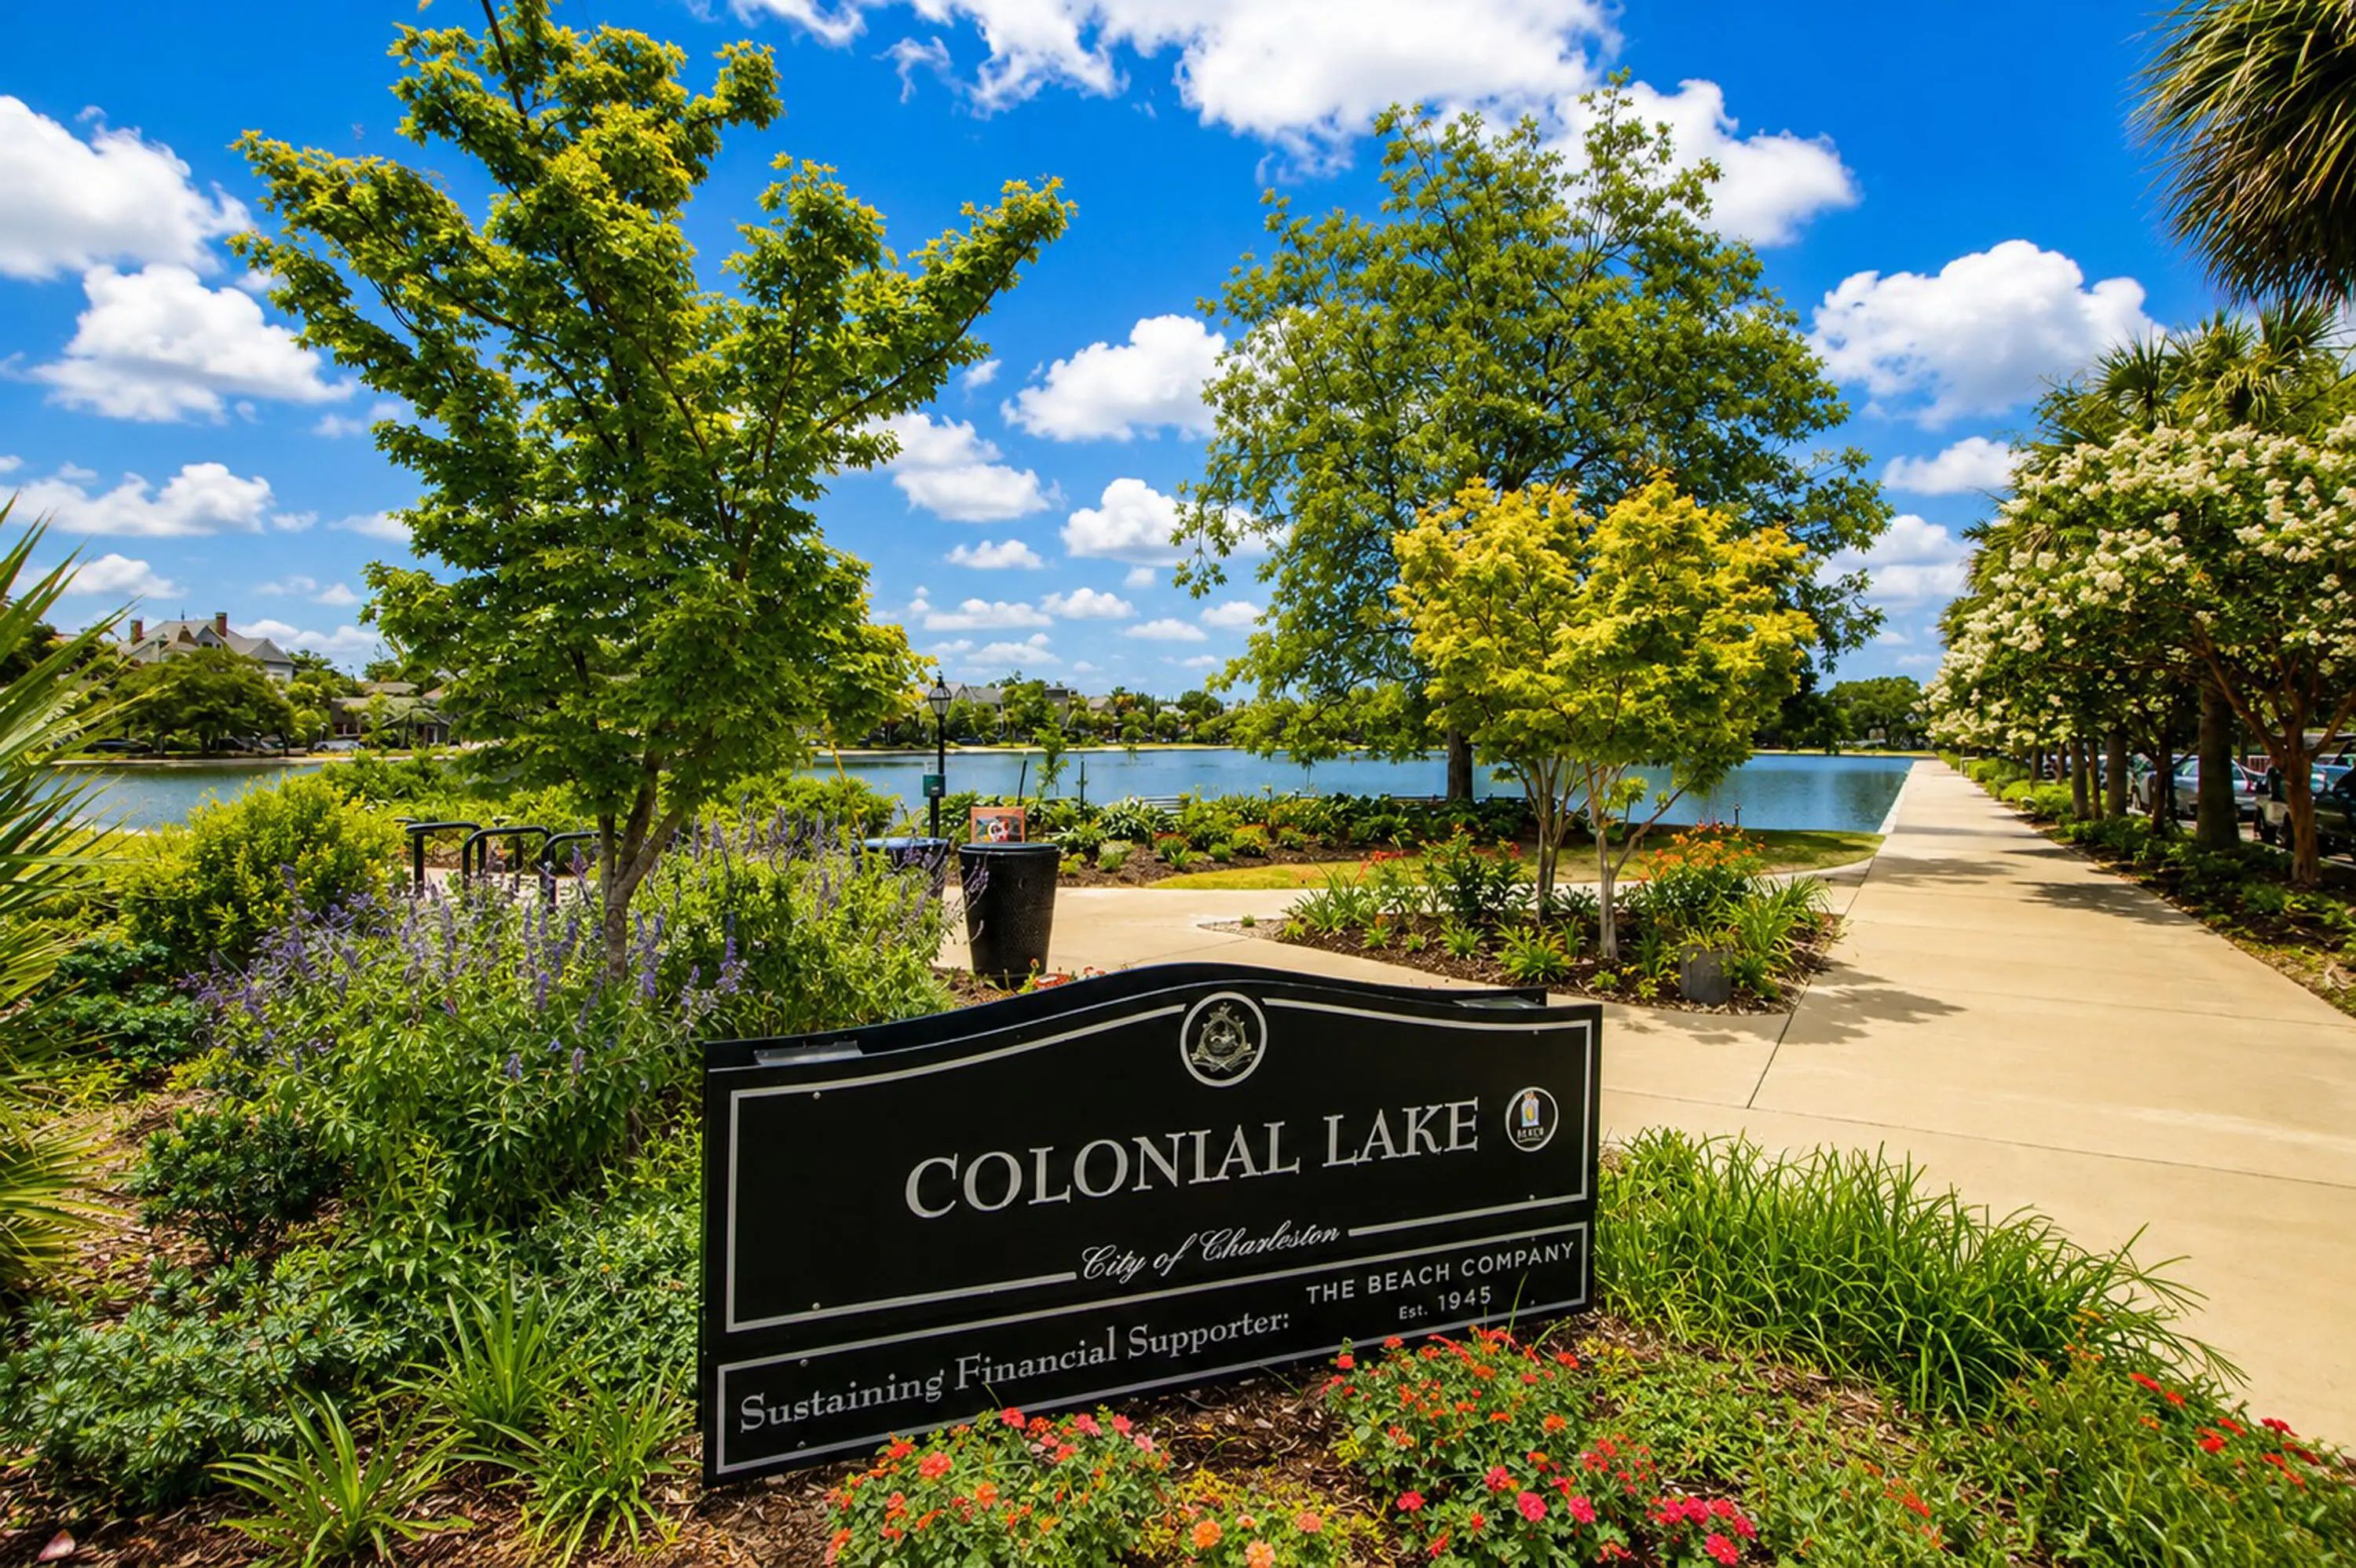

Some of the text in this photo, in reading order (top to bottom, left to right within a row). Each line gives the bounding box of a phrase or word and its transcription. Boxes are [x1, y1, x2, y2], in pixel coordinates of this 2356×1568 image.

[905, 1097, 1478, 1219] COLONIAL LAKE
[1081, 1219, 1340, 1285] City of Charleston
[1306, 1241, 1574, 1304] THE BEACH COMPANY
[1399, 1285, 1491, 1320] Est. 1945
[740, 1312, 1290, 1434] Sustaining Financial Supporter:
